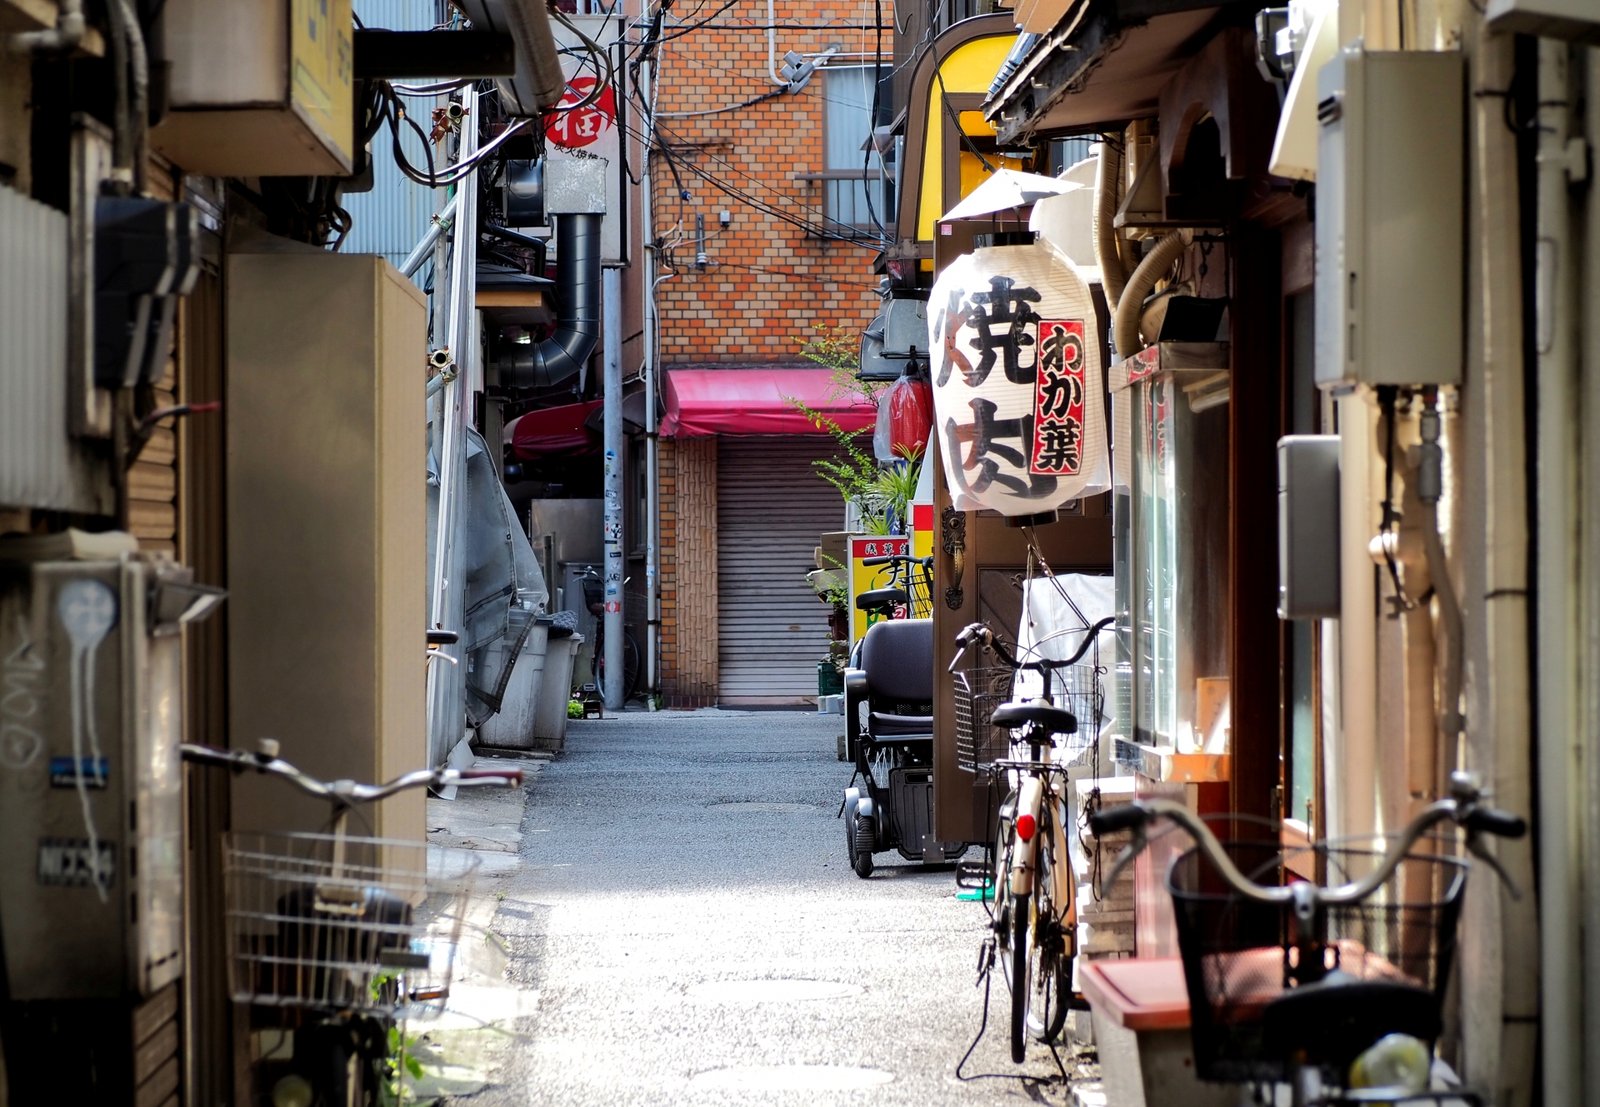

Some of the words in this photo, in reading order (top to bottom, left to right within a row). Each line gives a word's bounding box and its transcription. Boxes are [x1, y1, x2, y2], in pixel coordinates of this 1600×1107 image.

[933, 275, 1057, 499] 焼肉
[1036, 326, 1085, 471] わか葉
